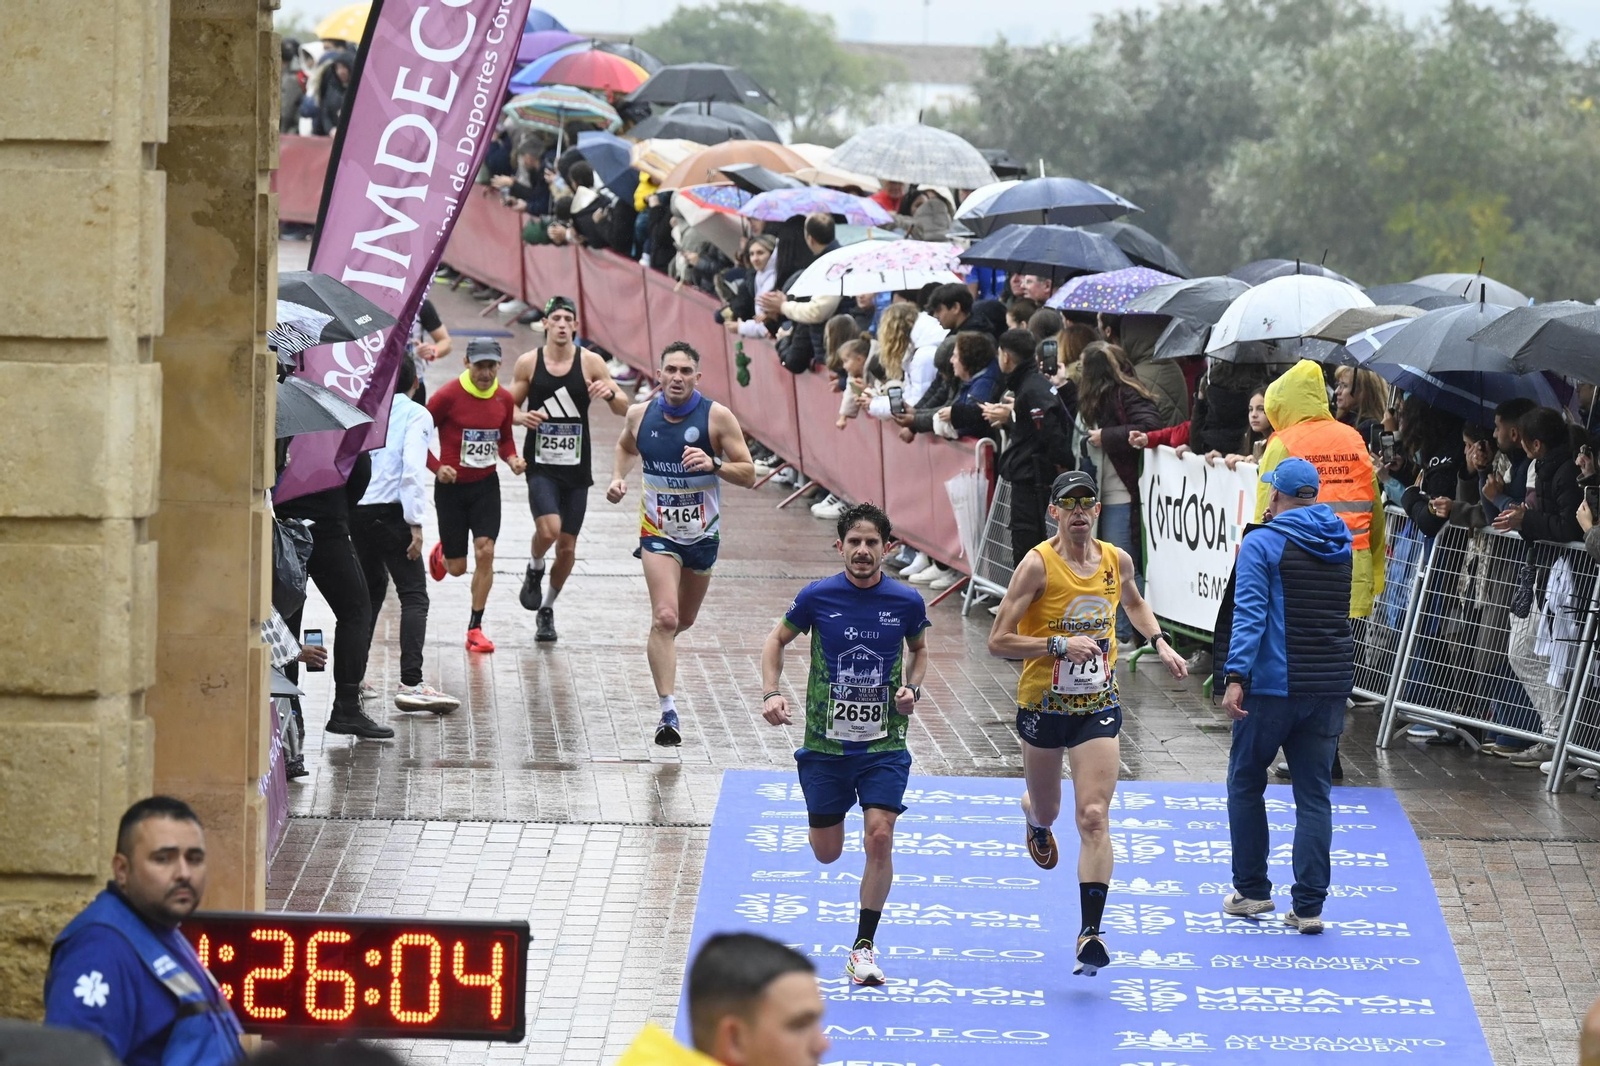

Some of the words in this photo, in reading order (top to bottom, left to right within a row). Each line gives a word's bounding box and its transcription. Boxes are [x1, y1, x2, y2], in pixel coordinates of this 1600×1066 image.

[457, 50, 498, 156] Deportes
[342, 0, 477, 294] IMDEC
[450, 162, 470, 192] de
[542, 436, 575, 450] 2548
[1304, 455, 1332, 463] PERSONAL
[1333, 453, 1360, 463] AUXILIAR
[653, 461, 701, 474] MOSQU
[1317, 467, 1328, 475] DEL
[1328, 466, 1350, 475] EVENTO
[663, 507, 700, 523] 1164
[1198, 571, 1209, 599] ES
[1048, 618, 1091, 631] clínica
[860, 631, 880, 640] CEU
[851, 653, 870, 661] 15K
[843, 675, 876, 684] Sevilla
[833, 702, 881, 722] 2658
[1173, 839, 1295, 851] MEA
[1174, 848, 1387, 861] MAAÓN
[733, 903, 809, 916] 39
[818, 900, 955, 912] MDIA
[818, 908, 1040, 922] MRATÓN
[1102, 914, 1176, 927] 39
[1183, 910, 1286, 921] MEDI
[815, 915, 953, 927] CÓDOBA
[970, 921, 1042, 929] 2025
[1185, 918, 1408, 931] MARTÓN
[1185, 927, 1302, 936] CÓRDOB
[1340, 930, 1412, 938] 2025
[1210, 954, 1421, 966] AYUNTAMIENTO
[815, 977, 955, 988] MDIA
[1109, 989, 1188, 1003] 39
[1195, 985, 1341, 998] MEDIA
[971, 998, 1046, 1007] 2025
[1197, 994, 1433, 1008] MARATÓN
[1197, 1003, 1343, 1014] CÓRDOBA
[822, 1025, 1050, 1041] MDECO
[1224, 1034, 1447, 1047] AYUNTAMIENTO
[1225, 1041, 1261, 1050] DE
